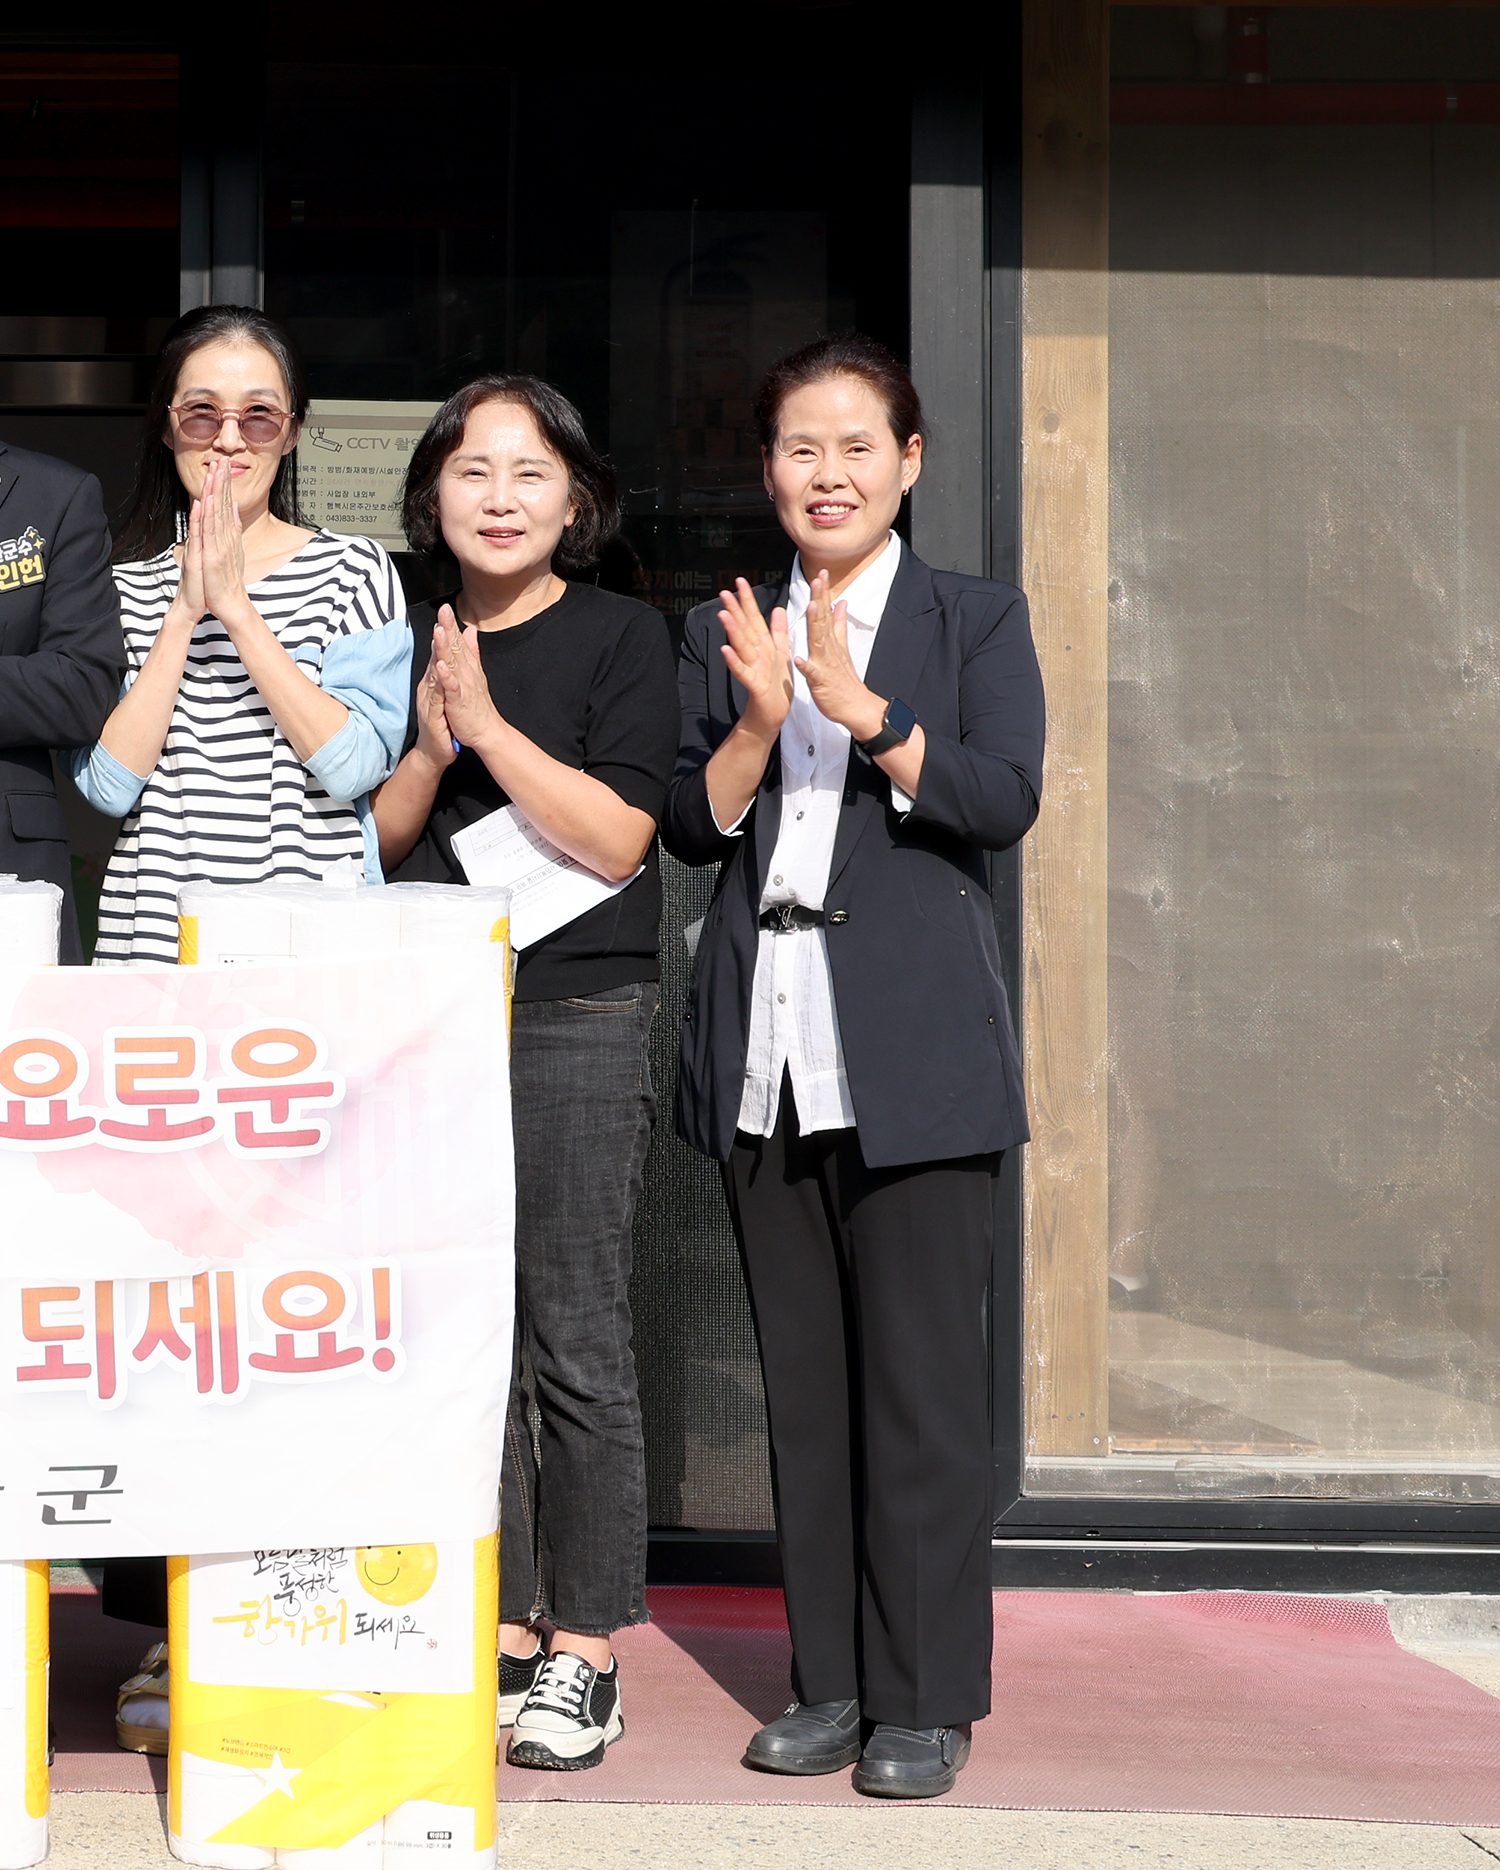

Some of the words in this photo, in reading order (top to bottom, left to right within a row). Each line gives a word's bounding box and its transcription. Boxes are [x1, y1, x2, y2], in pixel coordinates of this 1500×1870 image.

[346, 437, 391, 450] CCTV
[326, 490, 349, 498] 사업장
[353, 490, 376, 498] 내외부
[325, 514, 378, 523] 043)833-3337
[17, 1267, 396, 1401] 되세요!
[212, 1594, 348, 1646] 한가위
[353, 1612, 426, 1650] 되세요
